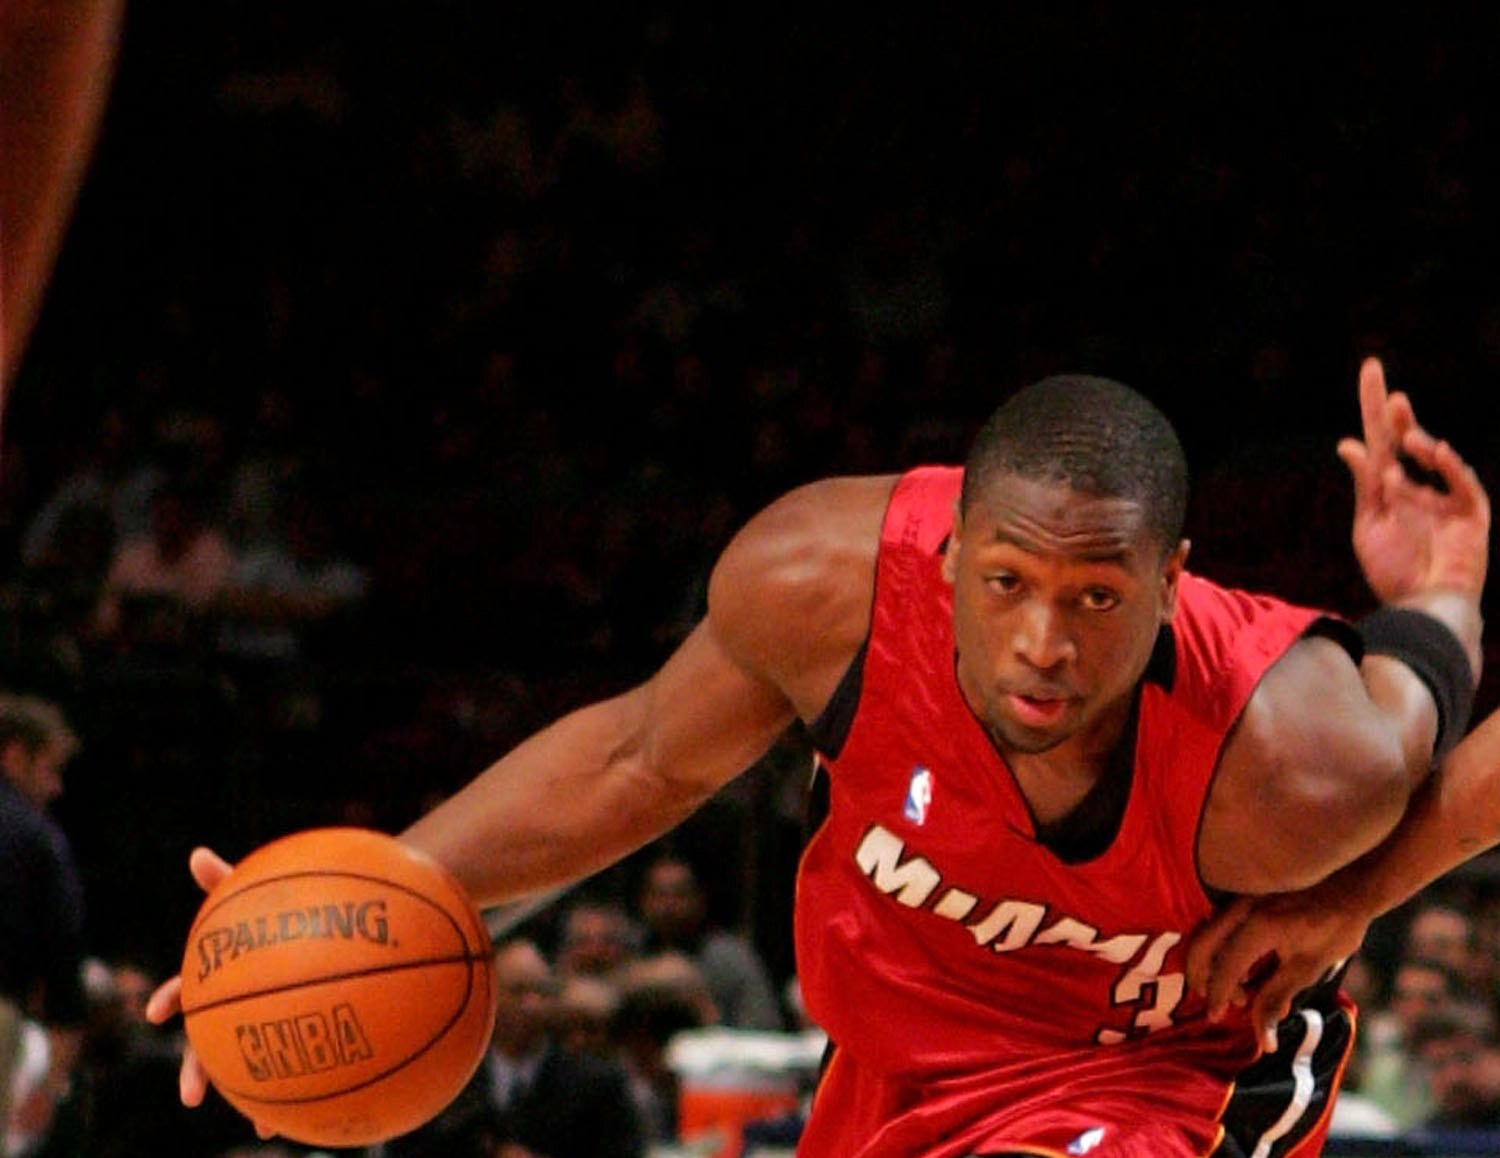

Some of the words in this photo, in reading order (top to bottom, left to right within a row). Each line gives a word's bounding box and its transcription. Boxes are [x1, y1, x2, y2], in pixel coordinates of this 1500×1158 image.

[855, 824, 1182, 970] MIAMI
[196, 898, 395, 983] SPALDING
[258, 1002, 373, 1080] NBA
[1098, 962, 1187, 1046] 3
